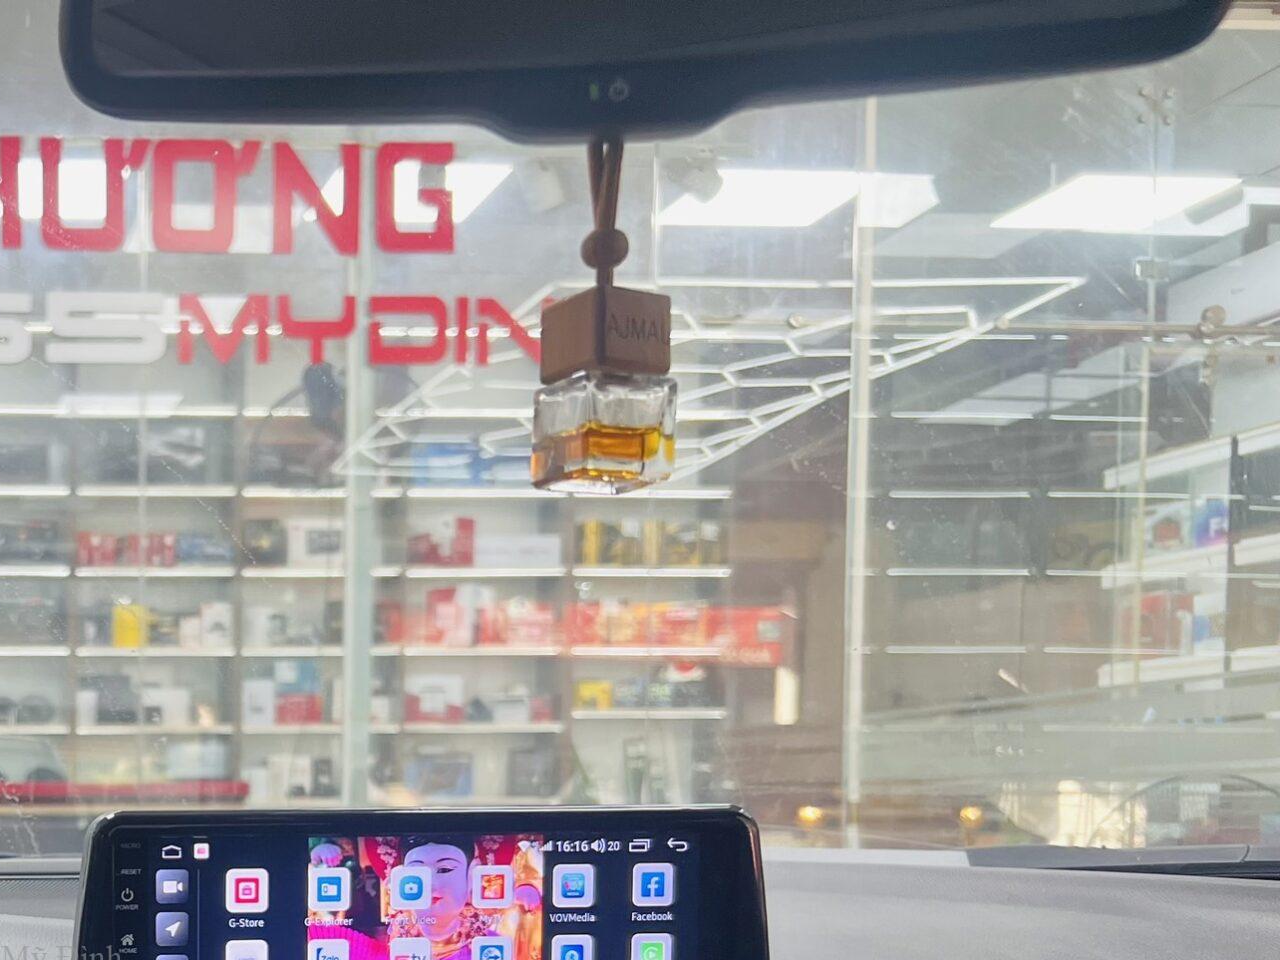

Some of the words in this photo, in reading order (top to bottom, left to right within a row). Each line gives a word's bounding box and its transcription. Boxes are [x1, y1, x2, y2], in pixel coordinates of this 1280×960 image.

[556, 840, 588, 852] 16:16
[607, 841, 620, 851] 20
[549, 912, 596, 922] VOVMedia
[631, 911, 673, 921] Facebook
[228, 918, 265, 928] G-Store
[304, 917, 354, 927] G-Explorer
